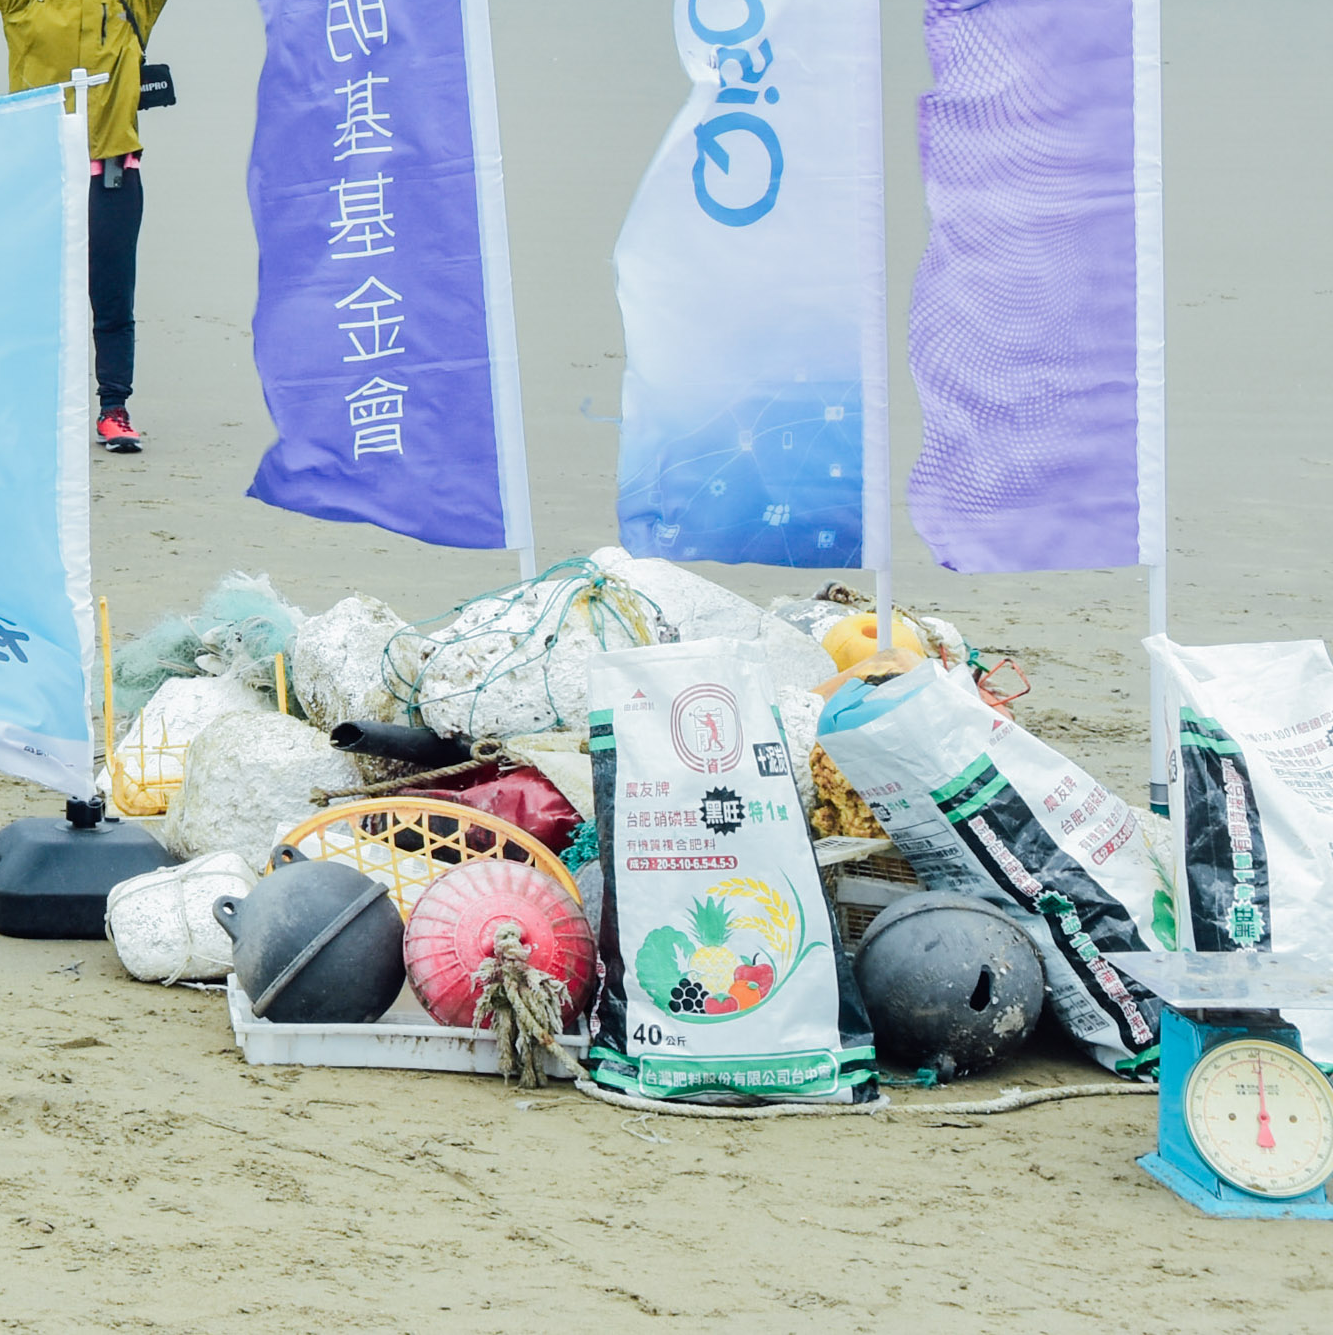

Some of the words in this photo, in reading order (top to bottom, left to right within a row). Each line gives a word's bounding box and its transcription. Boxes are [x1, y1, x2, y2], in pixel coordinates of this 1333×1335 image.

[625, 781, 670, 799] 農友牌
[1043, 775, 1079, 814] 農友牌
[626, 811, 651, 829] 台肥
[654, 810, 698, 828] 硝磷基
[705, 800, 741, 825] 黑旺
[626, 837, 717, 852] 有機質複合肥料
[633, 1023, 662, 1046] 40
[665, 1035, 687, 1047] 公斤
[644, 1064, 832, 1088] 台灣肥料股份有限公司台中廠
